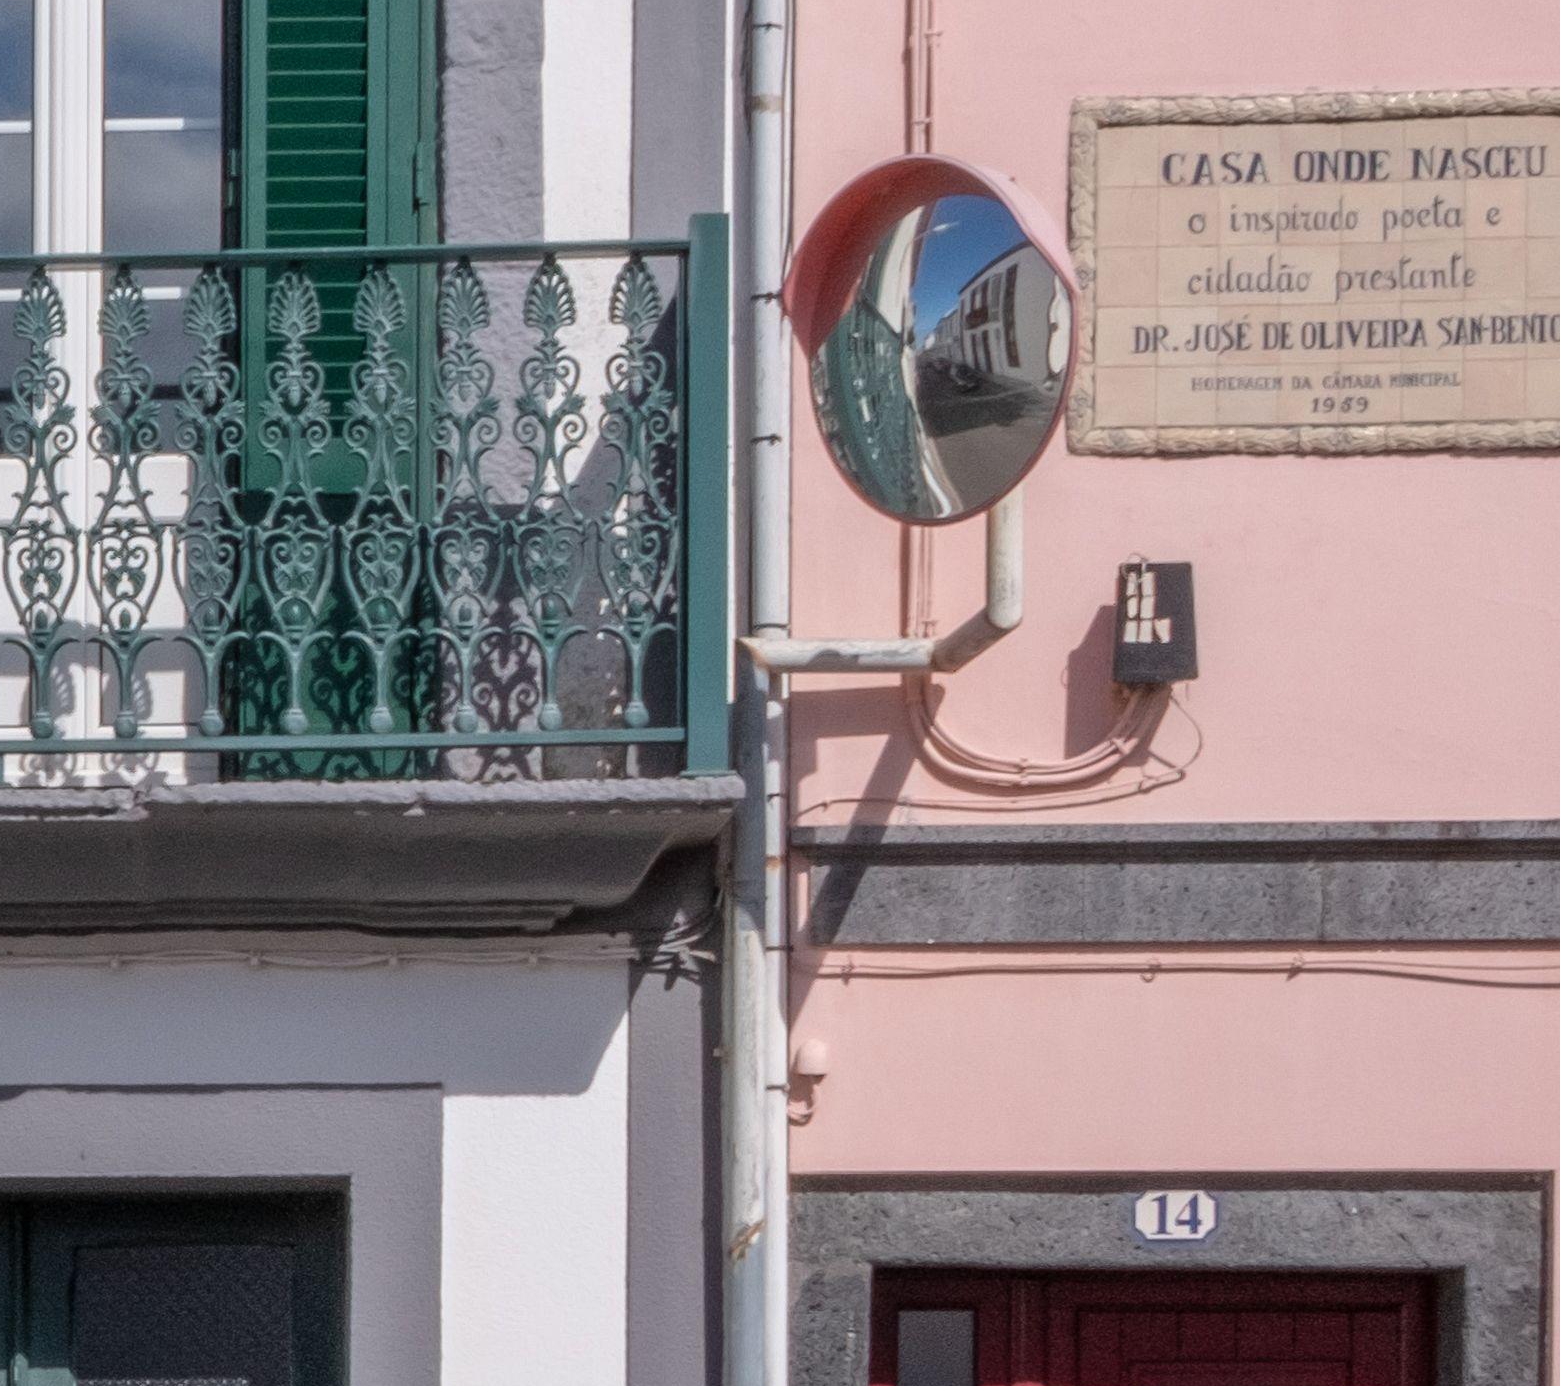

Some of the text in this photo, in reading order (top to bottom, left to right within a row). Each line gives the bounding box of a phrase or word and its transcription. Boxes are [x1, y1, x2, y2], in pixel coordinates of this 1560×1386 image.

[1161, 144, 1548, 187] CASA ONDE NASCEU
[1187, 194, 1502, 244] o inspirado poeta e
[1186, 251, 1477, 304] cidadão prestante
[1131, 323, 1179, 355] DR.
[1184, 313, 1252, 356] JOSÉ
[1261, 321, 1294, 352] DE
[1301, 317, 1428, 351] OLIVEIRA
[1291, 375, 1313, 390] DA
[1150, 1193, 1203, 1236] 14
